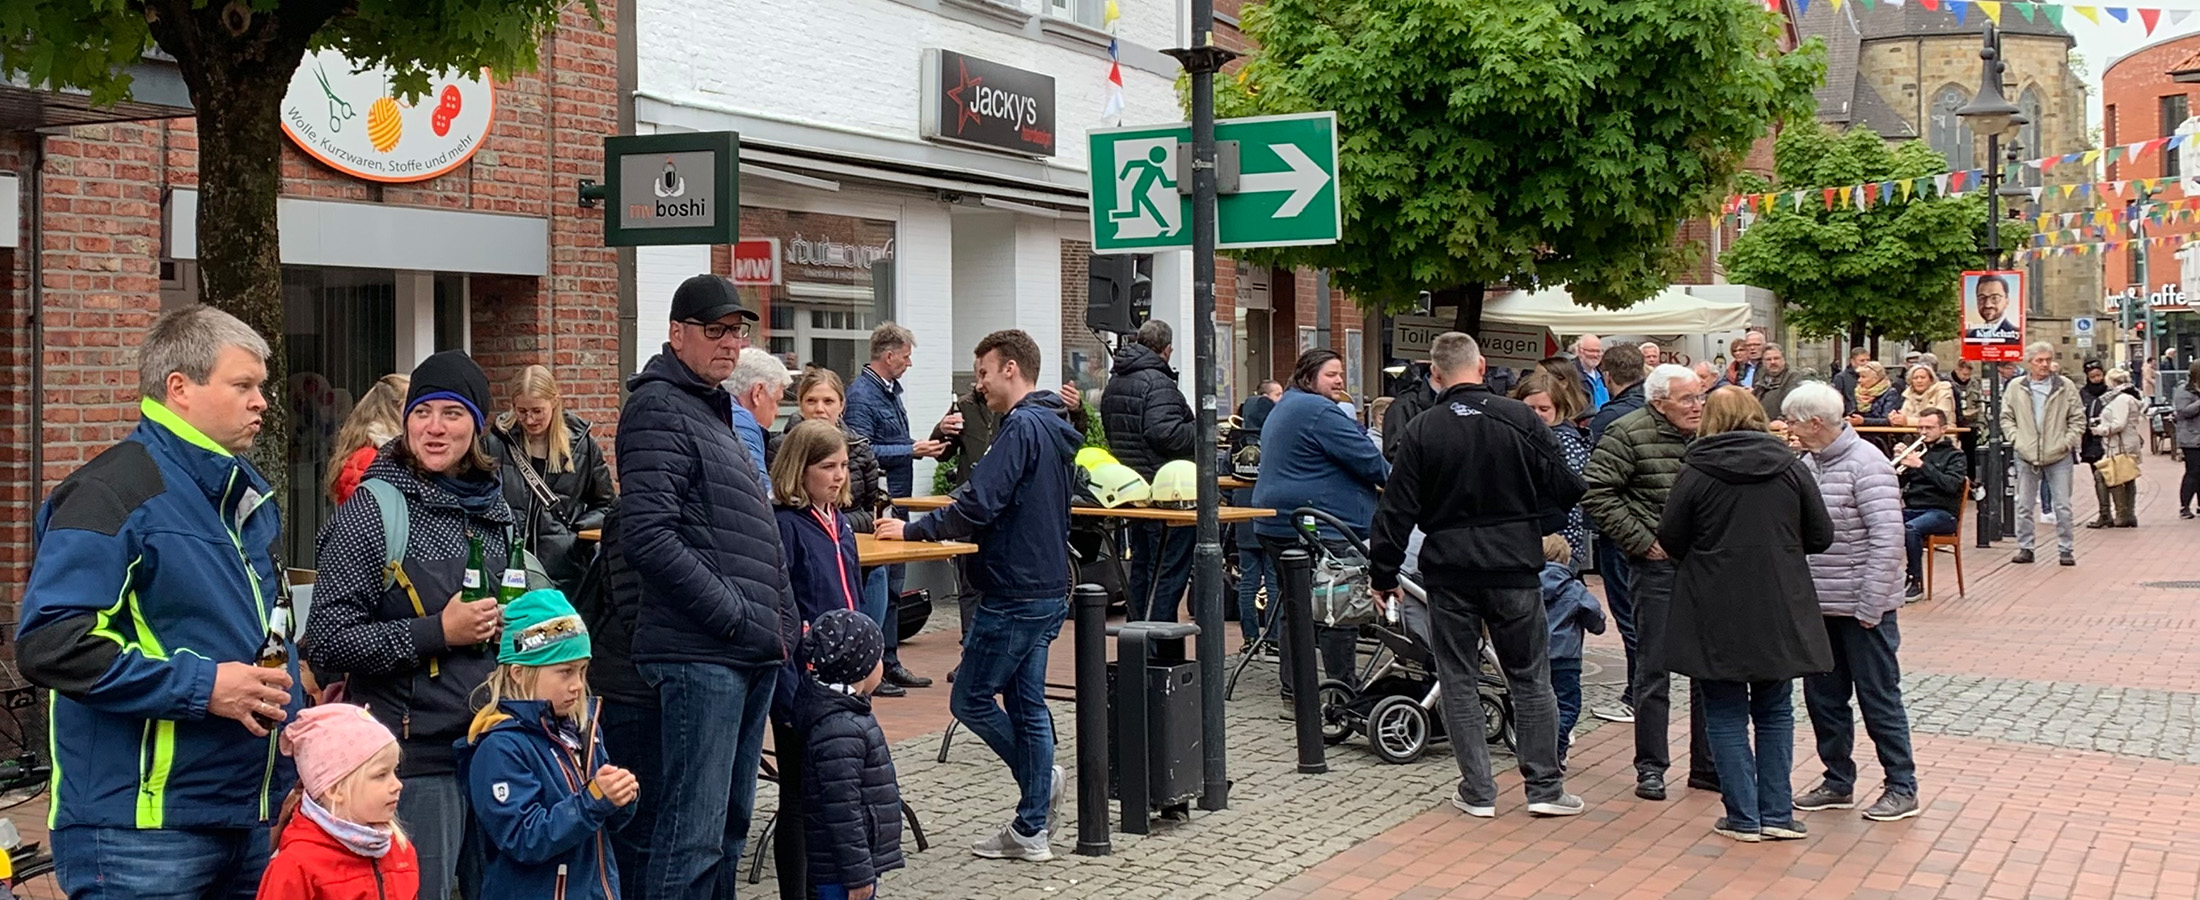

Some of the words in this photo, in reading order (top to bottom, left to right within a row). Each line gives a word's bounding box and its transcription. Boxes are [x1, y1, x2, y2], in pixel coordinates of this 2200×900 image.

[969, 85, 1037, 132] Jacky's
[288, 106, 318, 144] Wolle,
[319, 137, 386, 172] Kurzwaren,
[388, 160, 423, 173] Stoffe
[425, 152, 448, 169] und
[448, 133, 474, 160] mehr
